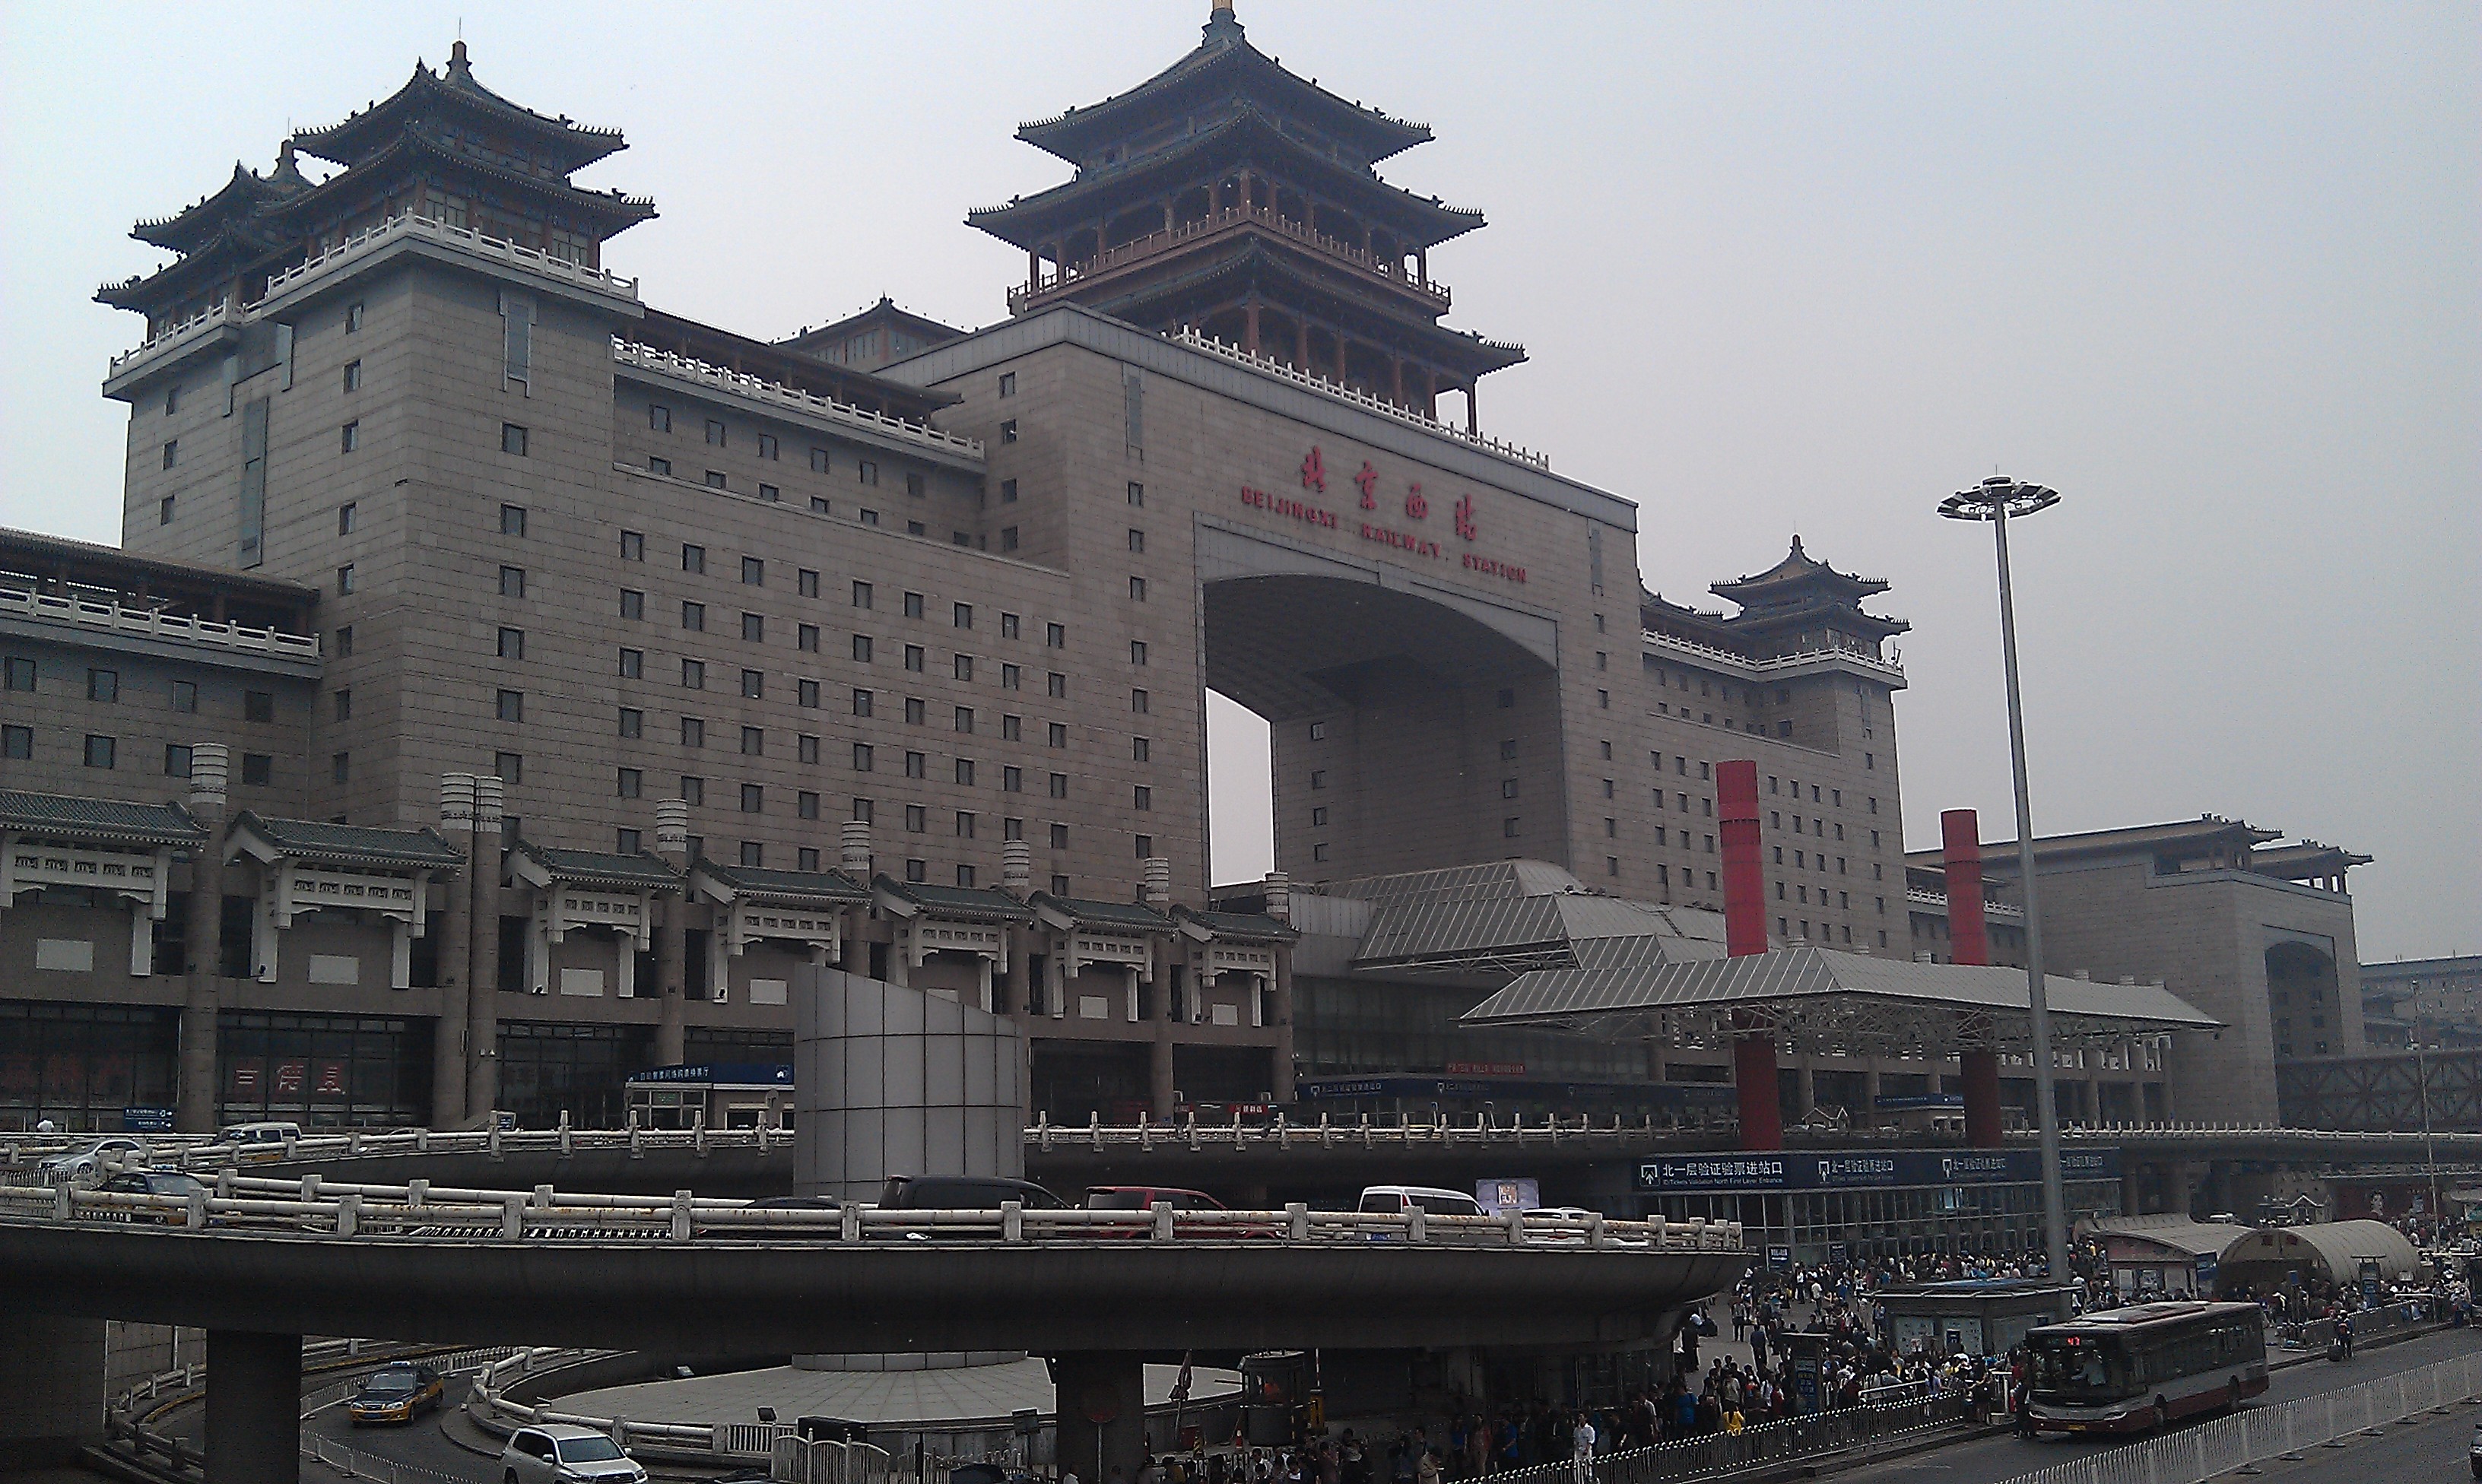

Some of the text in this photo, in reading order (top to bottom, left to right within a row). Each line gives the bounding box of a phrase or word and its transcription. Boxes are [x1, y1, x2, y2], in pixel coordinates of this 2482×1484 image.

[1241, 485, 1528, 583] BEIJINGXI RAILWAY STATION
[1301, 445, 1477, 541] 北京西站
[1662, 1160, 1783, 1177] 北一层验证验票进站口
